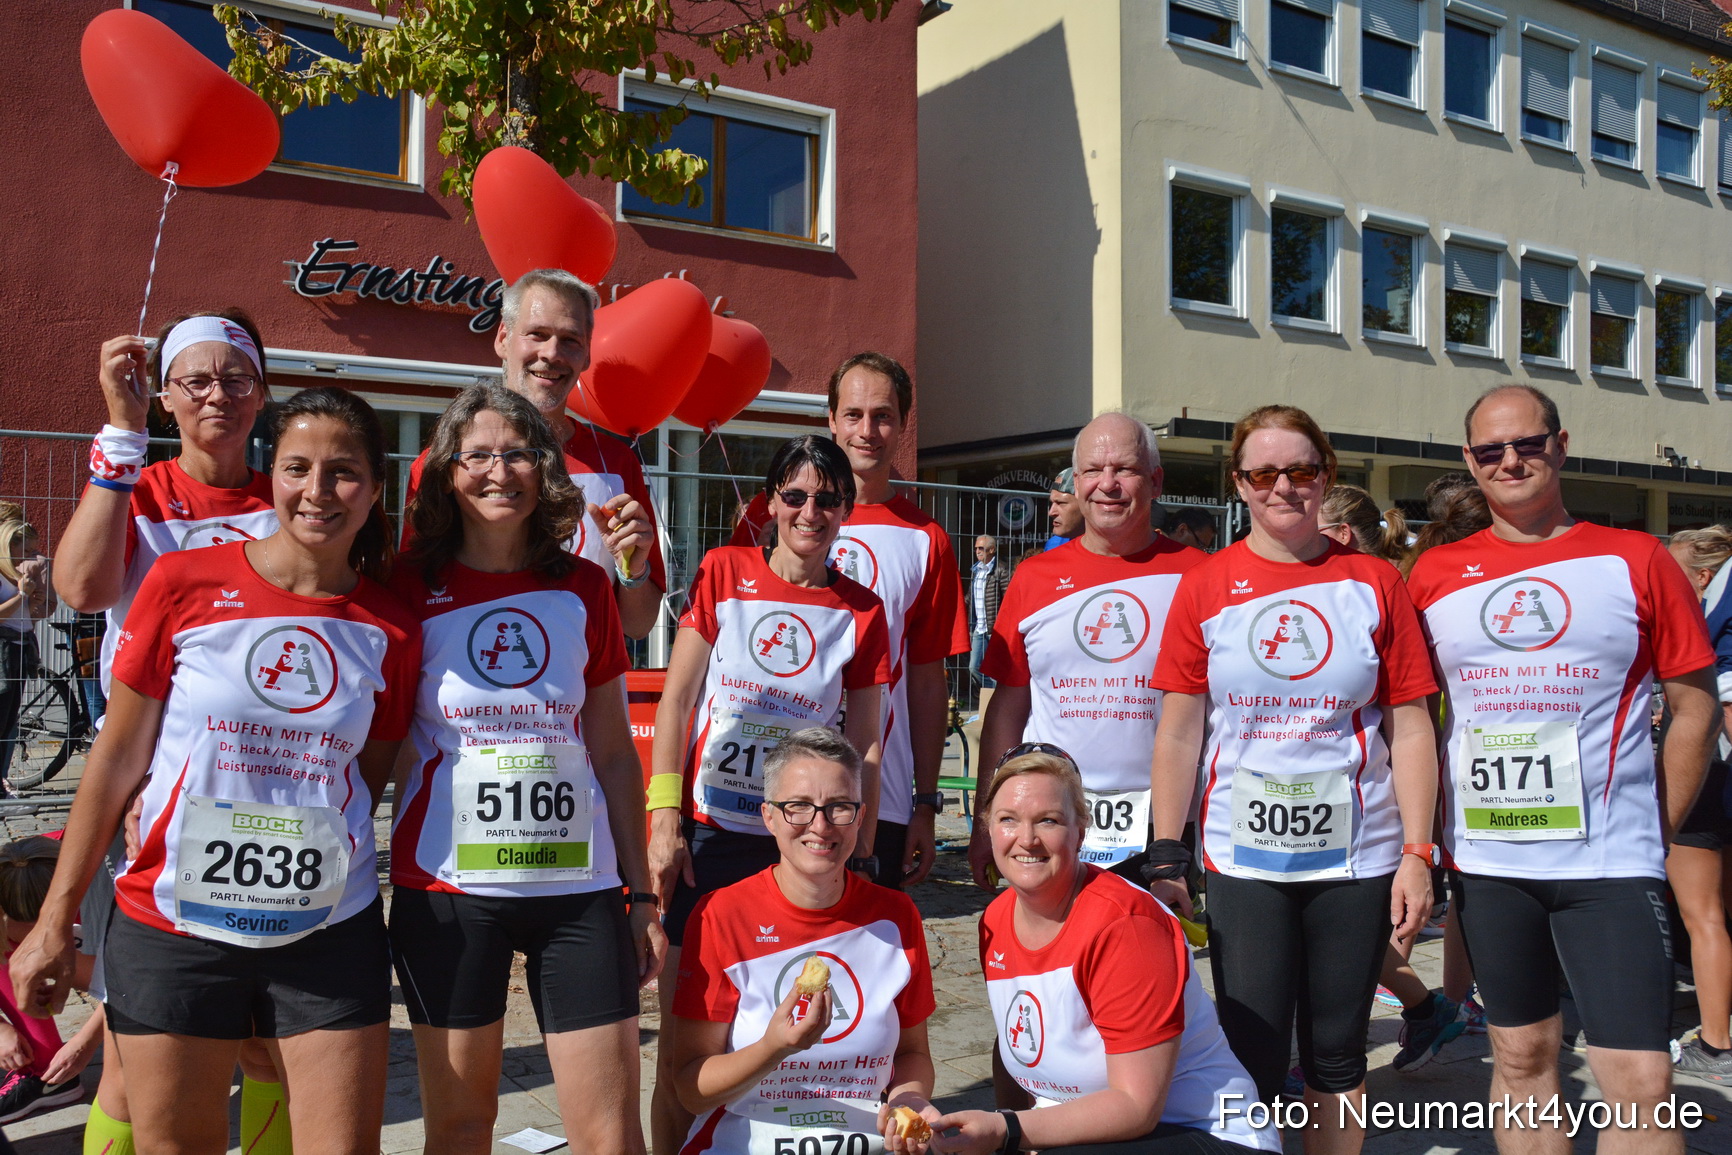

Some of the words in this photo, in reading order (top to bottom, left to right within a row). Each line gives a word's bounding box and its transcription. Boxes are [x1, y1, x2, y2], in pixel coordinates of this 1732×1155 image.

[1185, 494, 1218, 505] MÜLLER
[1686, 504, 1713, 518] Studio
[736, 585, 758, 594] erima
[1056, 583, 1075, 591] erima
[1231, 587, 1253, 595] erima
[213, 600, 245, 608] erima
[426, 595, 454, 605] erima
[1473, 688, 1485, 697] Dr.
[1486, 685, 1511, 696] Heck
[1522, 685, 1540, 694] Dr.
[1543, 684, 1584, 696] Röschl
[729, 694, 740, 703] Dr.
[741, 696, 762, 707] Heck
[769, 702, 781, 712] Dr.
[1059, 695, 1072, 703] Dr.
[1073, 695, 1098, 703] Heck
[1107, 695, 1121, 704] Dr.
[1123, 695, 1156, 705] Röschl
[1474, 700, 1581, 713] Leistungsdiagnostik
[1059, 708, 1154, 720] Leistungsdiagnostik
[1241, 714, 1253, 724] Dr.
[1255, 714, 1283, 724] Heck
[1293, 715, 1308, 724] Dr.
[460, 726, 476, 734] Dr.
[477, 720, 506, 732] Heck
[514, 721, 530, 730] Dr.
[1239, 728, 1340, 742] Leistungsdiagnostik
[1483, 733, 1538, 747] BOCK
[219, 741, 236, 752] Dr.
[240, 744, 270, 756] Heck
[282, 749, 299, 760] Dr.
[497, 755, 557, 770] BOCK
[717, 741, 779, 778] 21
[217, 759, 336, 786] Leistungsdiagnostik
[1471, 754, 1554, 791] 5171
[723, 778, 747, 789] PARTL
[1264, 780, 1315, 796] BOCK
[476, 780, 575, 823] 5166
[1480, 796, 1504, 804] PARTL
[1504, 796, 1543, 804] Neumarkt
[232, 812, 304, 835] BOCK
[1248, 799, 1333, 837] 3052
[1489, 812, 1548, 826] Andreas
[232, 828, 254, 836] inspired
[485, 829, 517, 837] PARTL
[518, 829, 558, 837] Neumarkt
[1254, 838, 1279, 847] PARTL
[1280, 841, 1316, 849] Neumarkt
[496, 847, 557, 865] Claudia
[201, 840, 323, 891] 2638
[210, 891, 245, 903] PARTL
[247, 894, 296, 905] Neumarkt
[225, 912, 289, 932] Sevinc
[755, 934, 780, 943] erima
[988, 960, 1006, 971] erima
[760, 1078, 777, 1086] Dr.
[780, 1074, 809, 1085] Heck
[819, 1075, 836, 1083] Dr.
[839, 1075, 877, 1086] Röschl
[760, 1087, 873, 1100] Leistungsdiagnostik
[789, 1110, 848, 1127] BOCK
